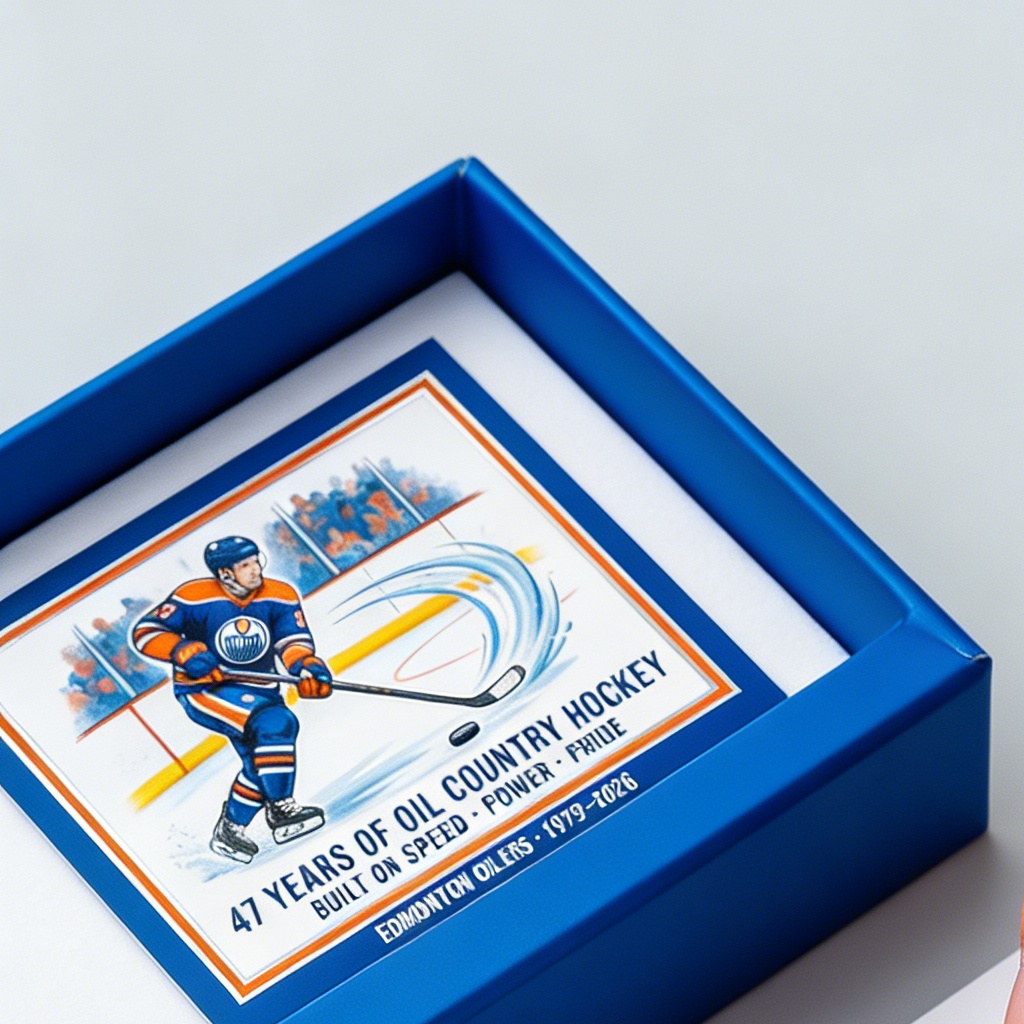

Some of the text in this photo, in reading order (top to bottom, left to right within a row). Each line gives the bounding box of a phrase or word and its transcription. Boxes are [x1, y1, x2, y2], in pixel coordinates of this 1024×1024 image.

[231, 650, 668, 932] 47 YEARS OF OIL COUNTRY HOCKEY
[310, 873, 368, 920] BUILT
[371, 856, 402, 883] ON
[401, 815, 469, 864] SPEED
[481, 762, 555, 815] POWER
